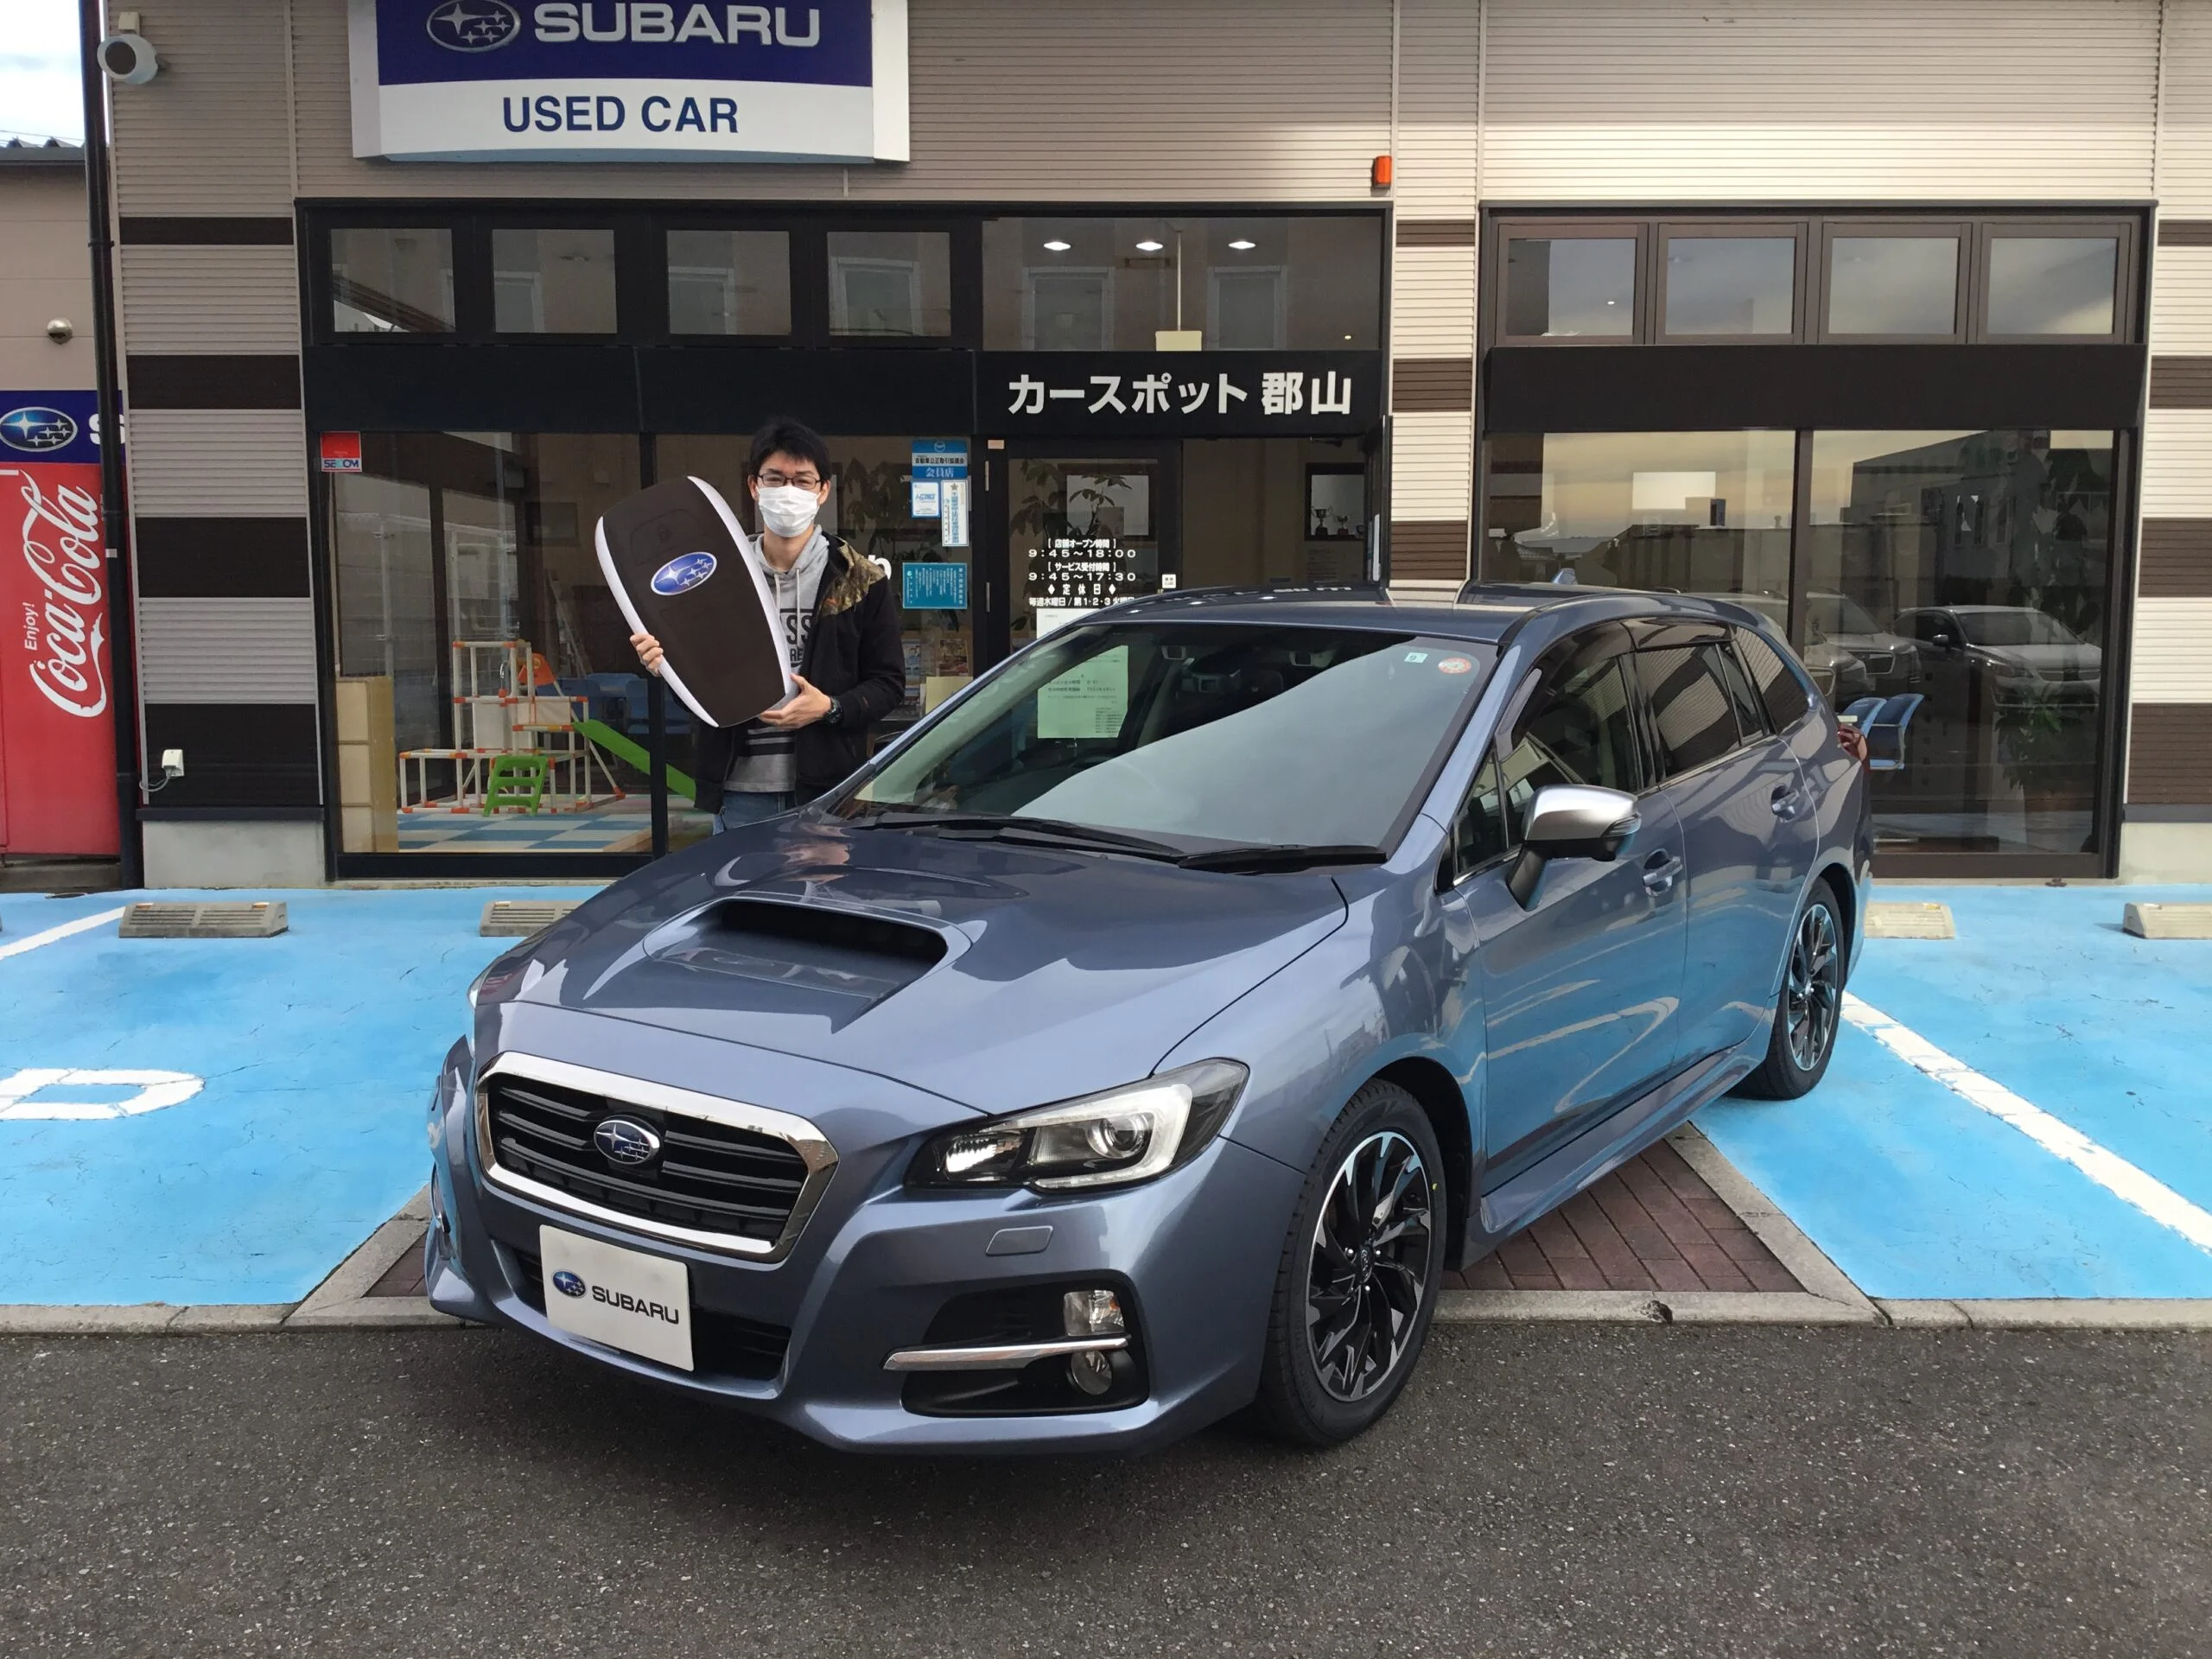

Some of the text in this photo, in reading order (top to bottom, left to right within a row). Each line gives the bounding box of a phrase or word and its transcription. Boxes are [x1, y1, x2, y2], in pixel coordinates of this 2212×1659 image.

[535, 3, 820, 48] SUBARU
[503, 96, 739, 134] USED CAR
[1008, 371, 1351, 415] カースポット 郡山
[925, 467, 954, 478] 会員店
[19, 469, 107, 718] Coca-Cola
[22, 601, 38, 651] Enjoy!
[592, 1285, 679, 1325] SUBARU
